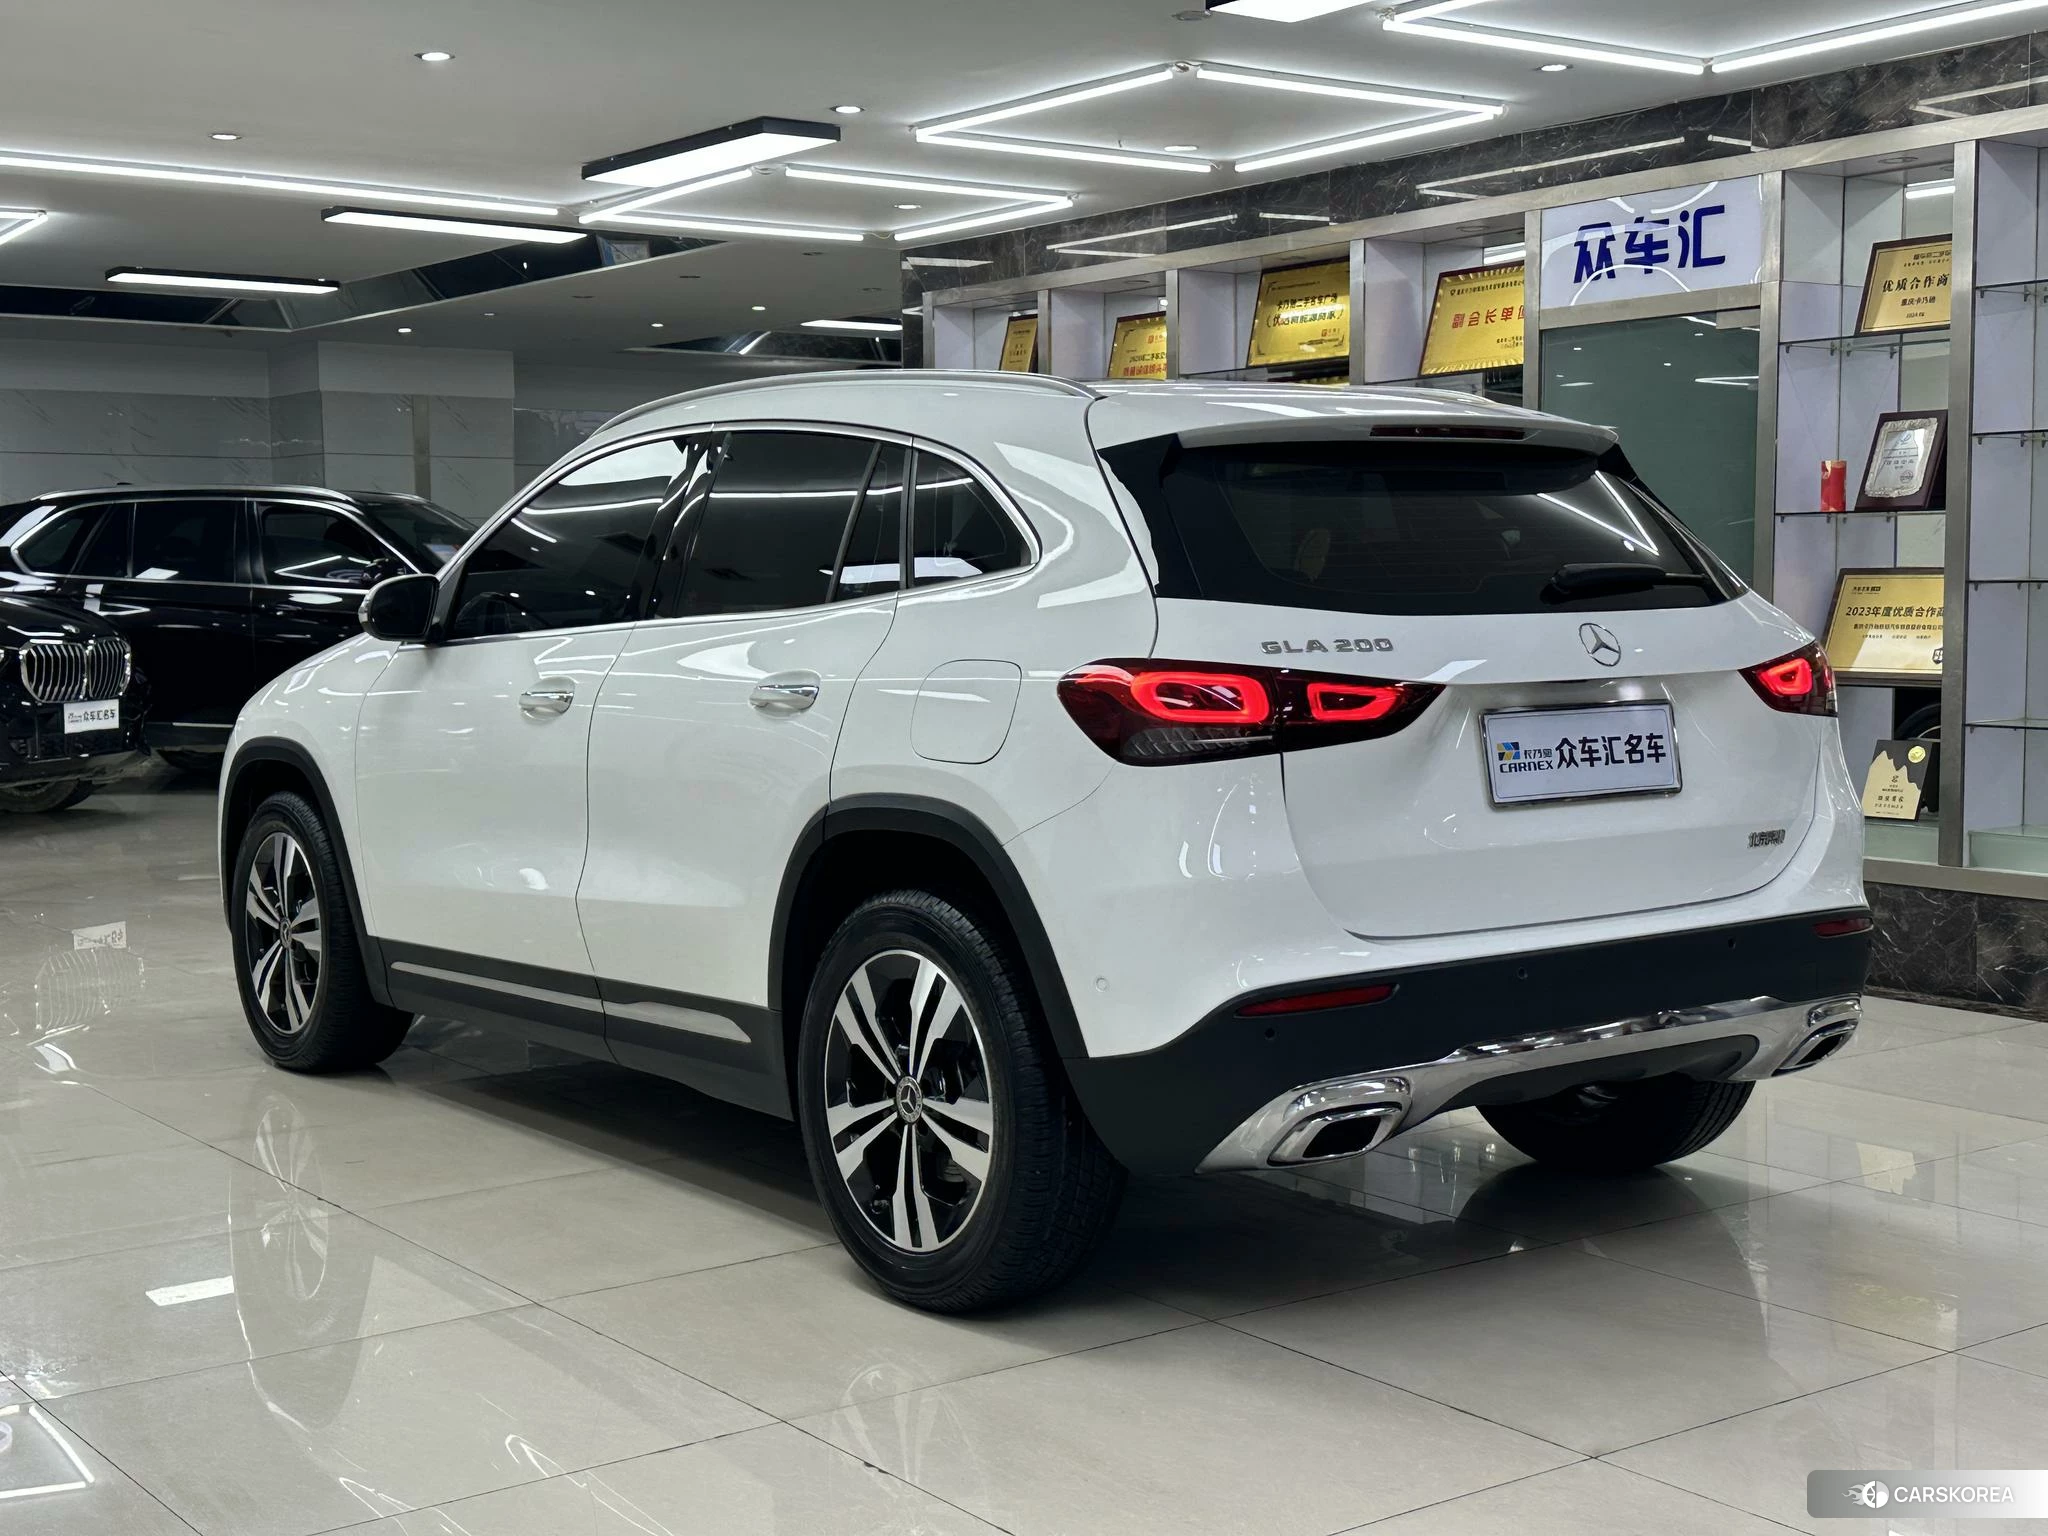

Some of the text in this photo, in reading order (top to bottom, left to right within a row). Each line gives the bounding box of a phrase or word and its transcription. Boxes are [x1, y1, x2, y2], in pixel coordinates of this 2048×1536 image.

[1573, 204, 1726, 284] 众车汇
[1882, 273, 1950, 293] 优质合作商
[1260, 638, 1394, 655] GLA 200
[1554, 732, 1667, 770] 众车汇名车
[1499, 760, 1554, 774] CARNEX
